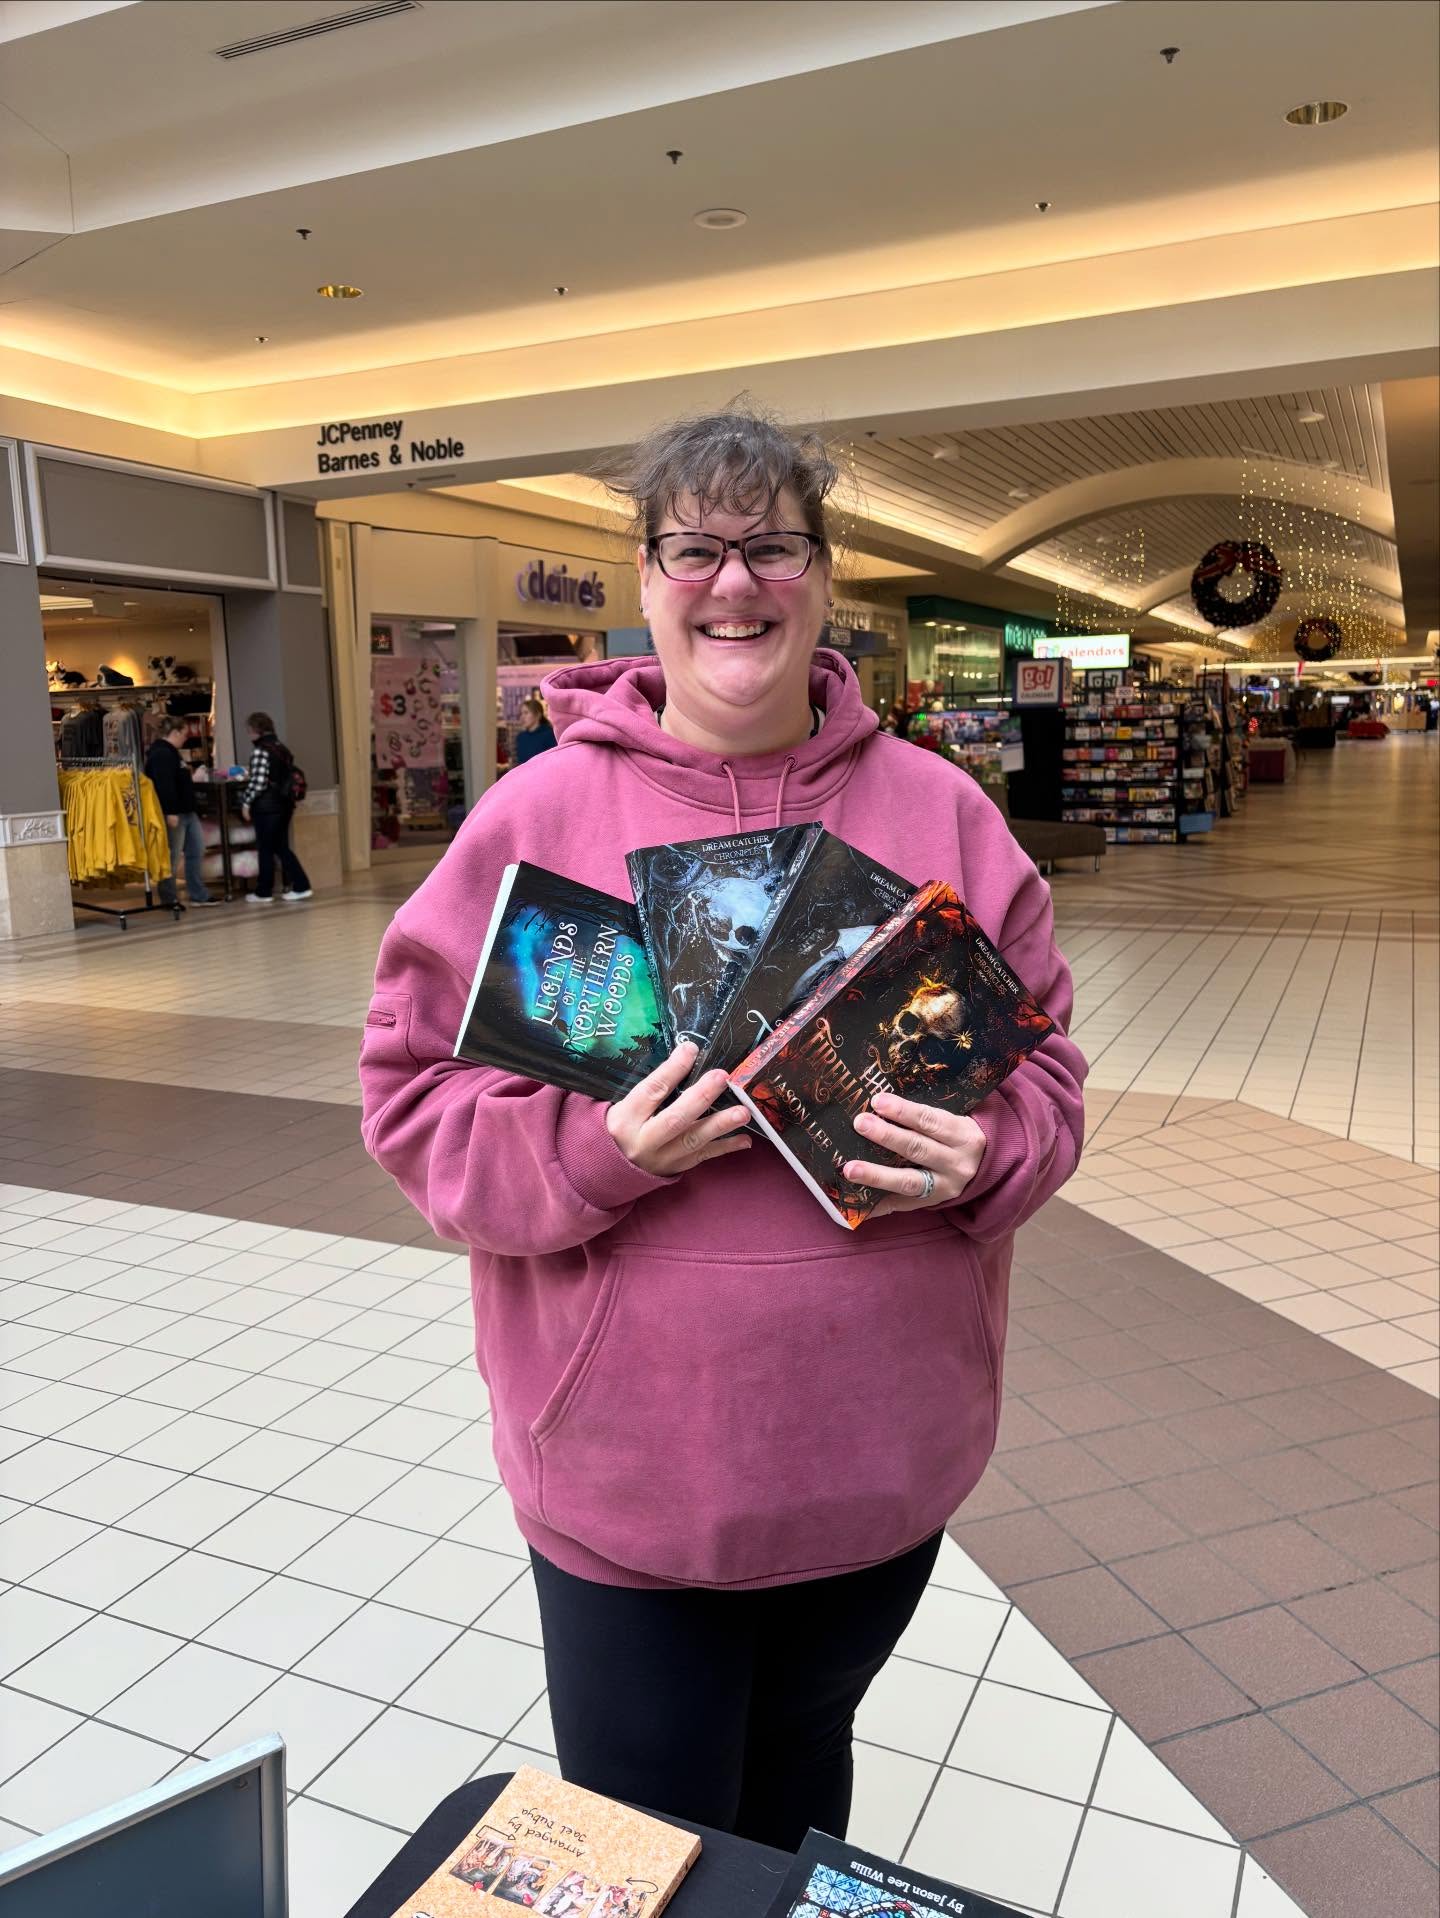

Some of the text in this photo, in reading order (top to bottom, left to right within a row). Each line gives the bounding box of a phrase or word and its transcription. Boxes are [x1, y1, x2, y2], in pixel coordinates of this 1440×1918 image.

[317, 420, 403, 446] JCPenney
[317, 436, 464, 474] Barnes & Noble
[1060, 645, 1125, 658] calendars
[1022, 666, 1054, 691] go!
[380, 693, 407, 716] $3
[713, 845, 764, 861] CHRONICLES
[870, 871, 897, 893] DREAM
[531, 921, 579, 1026] LEGENDS
[562, 954, 587, 1006] OF THE
[563, 923, 619, 1049] NORTHERN
[594, 953, 635, 1037] WOODS
[771, 1073, 832, 1152] JASON LEE
[508, 1816, 586, 1858] Arranged by
[521, 1807, 555, 1830] Dubya
[850, 1860, 965, 1914] By Jason Lee Willis
